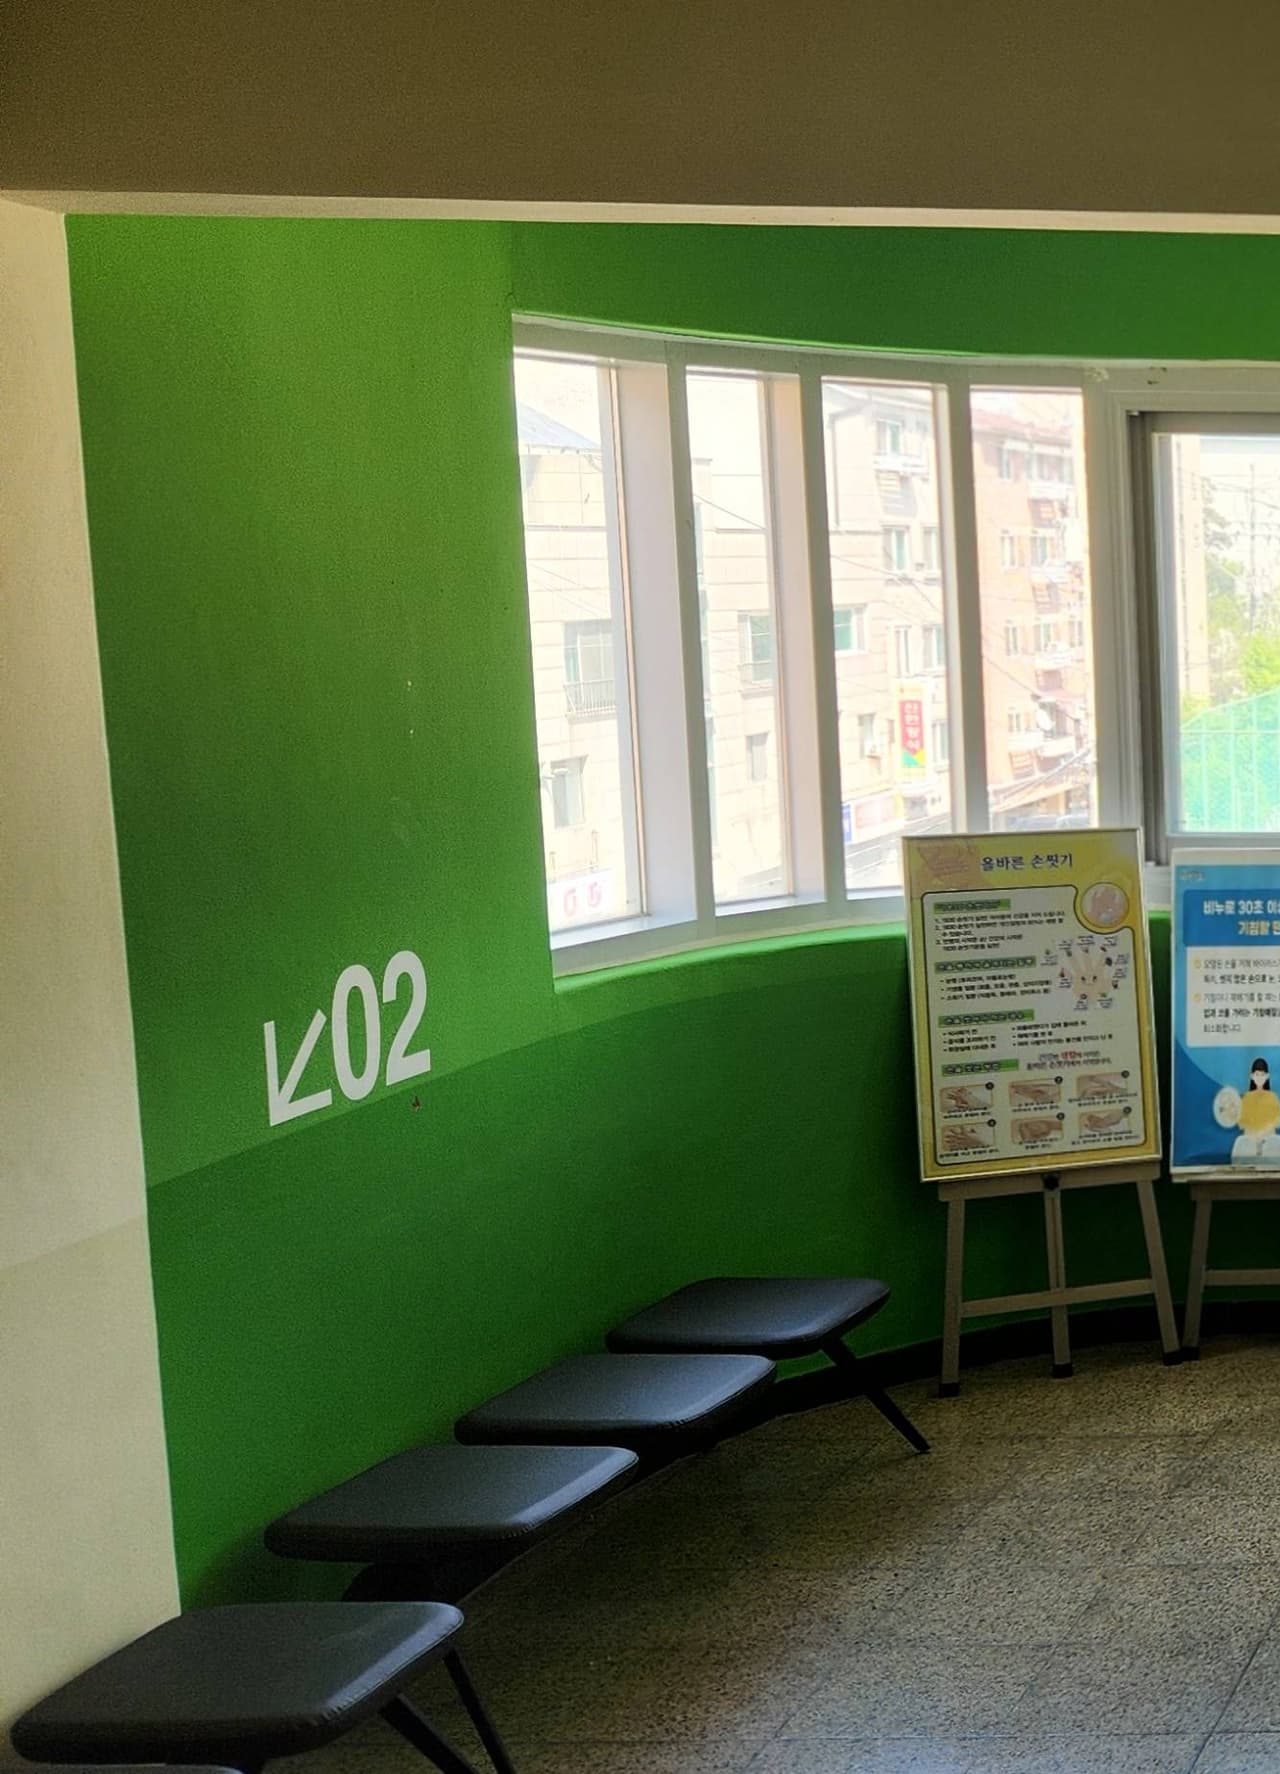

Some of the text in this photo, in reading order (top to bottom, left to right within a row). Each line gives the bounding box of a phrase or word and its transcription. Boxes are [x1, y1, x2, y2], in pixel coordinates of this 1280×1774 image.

[980, 853, 1073, 871] 올바른 손씻기
[1203, 899, 1235, 915] 비누로
[1238, 899, 1264, 915] 30초
[1238, 920, 1270, 935] 기침할
[332, 950, 431, 1101] 02
